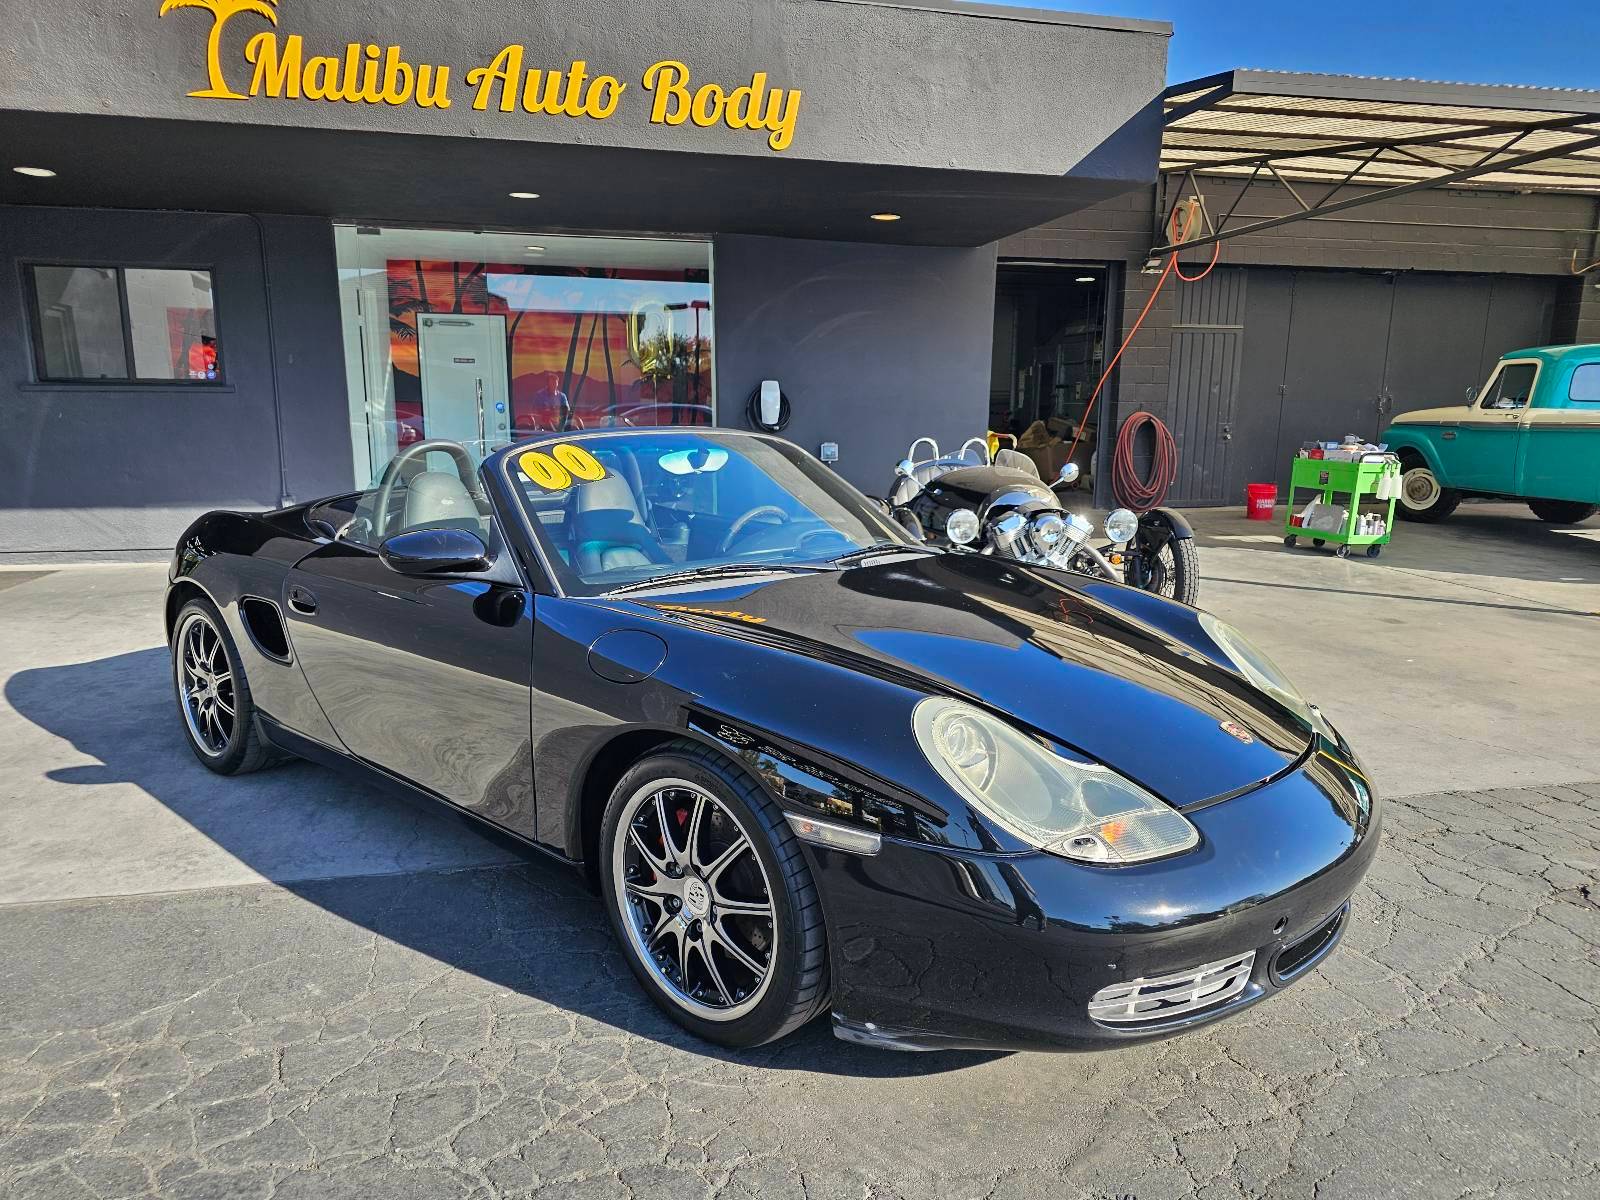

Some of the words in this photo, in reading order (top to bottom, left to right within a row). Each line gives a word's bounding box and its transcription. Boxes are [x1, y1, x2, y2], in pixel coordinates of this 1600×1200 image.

[245, 32, 452, 110] Malibu
[466, 45, 626, 119] Auto
[643, 60, 801, 151] Body
[518, 443, 606, 490] 00
